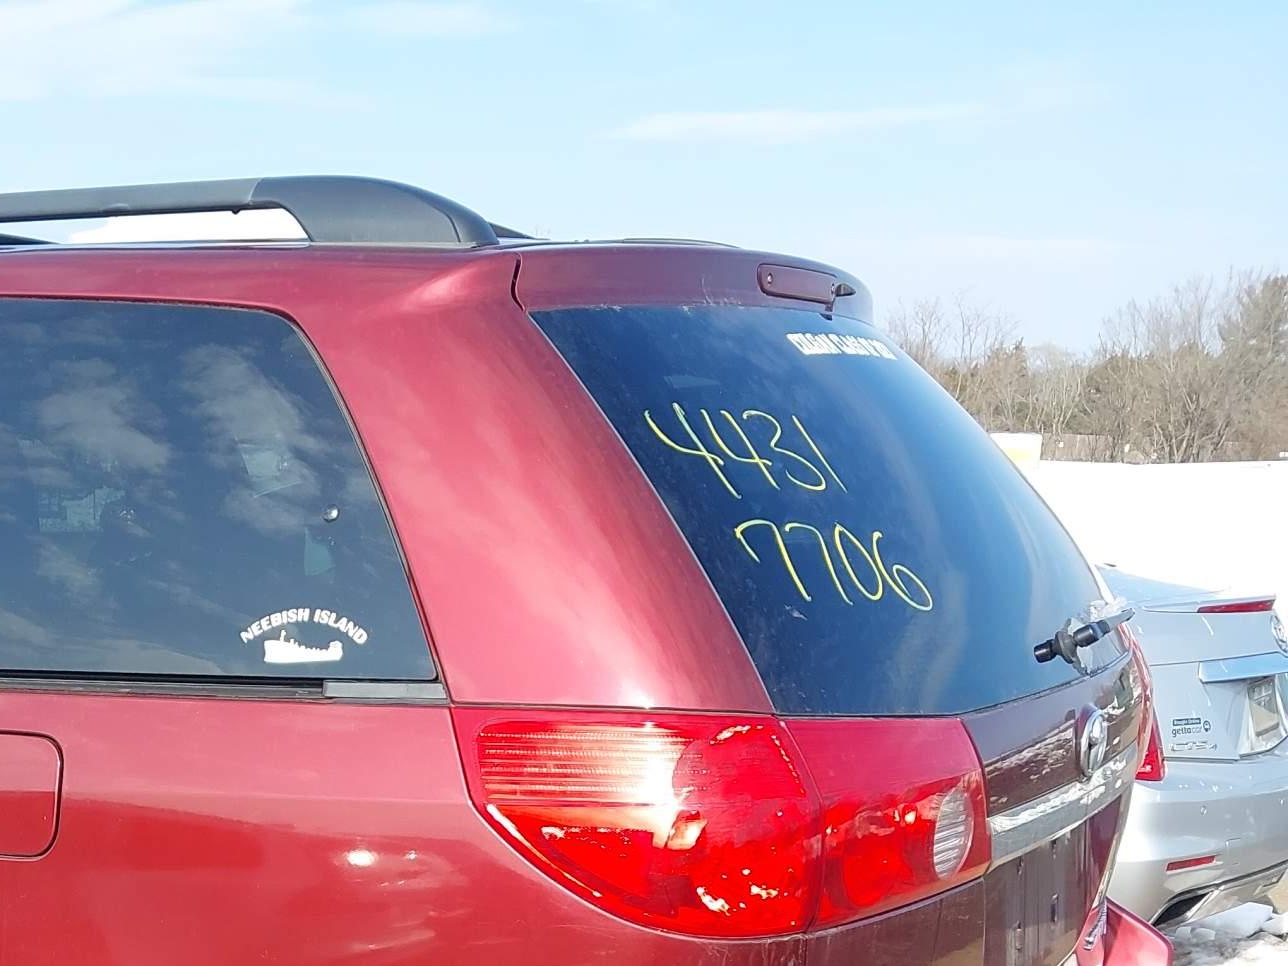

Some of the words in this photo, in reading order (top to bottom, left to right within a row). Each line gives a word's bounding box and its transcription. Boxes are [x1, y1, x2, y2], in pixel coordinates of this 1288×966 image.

[644, 402, 848, 499] 4431
[735, 519, 933, 611] 7706
[240, 608, 310, 644] NEEBISH
[313, 609, 368, 645] ISLAND
